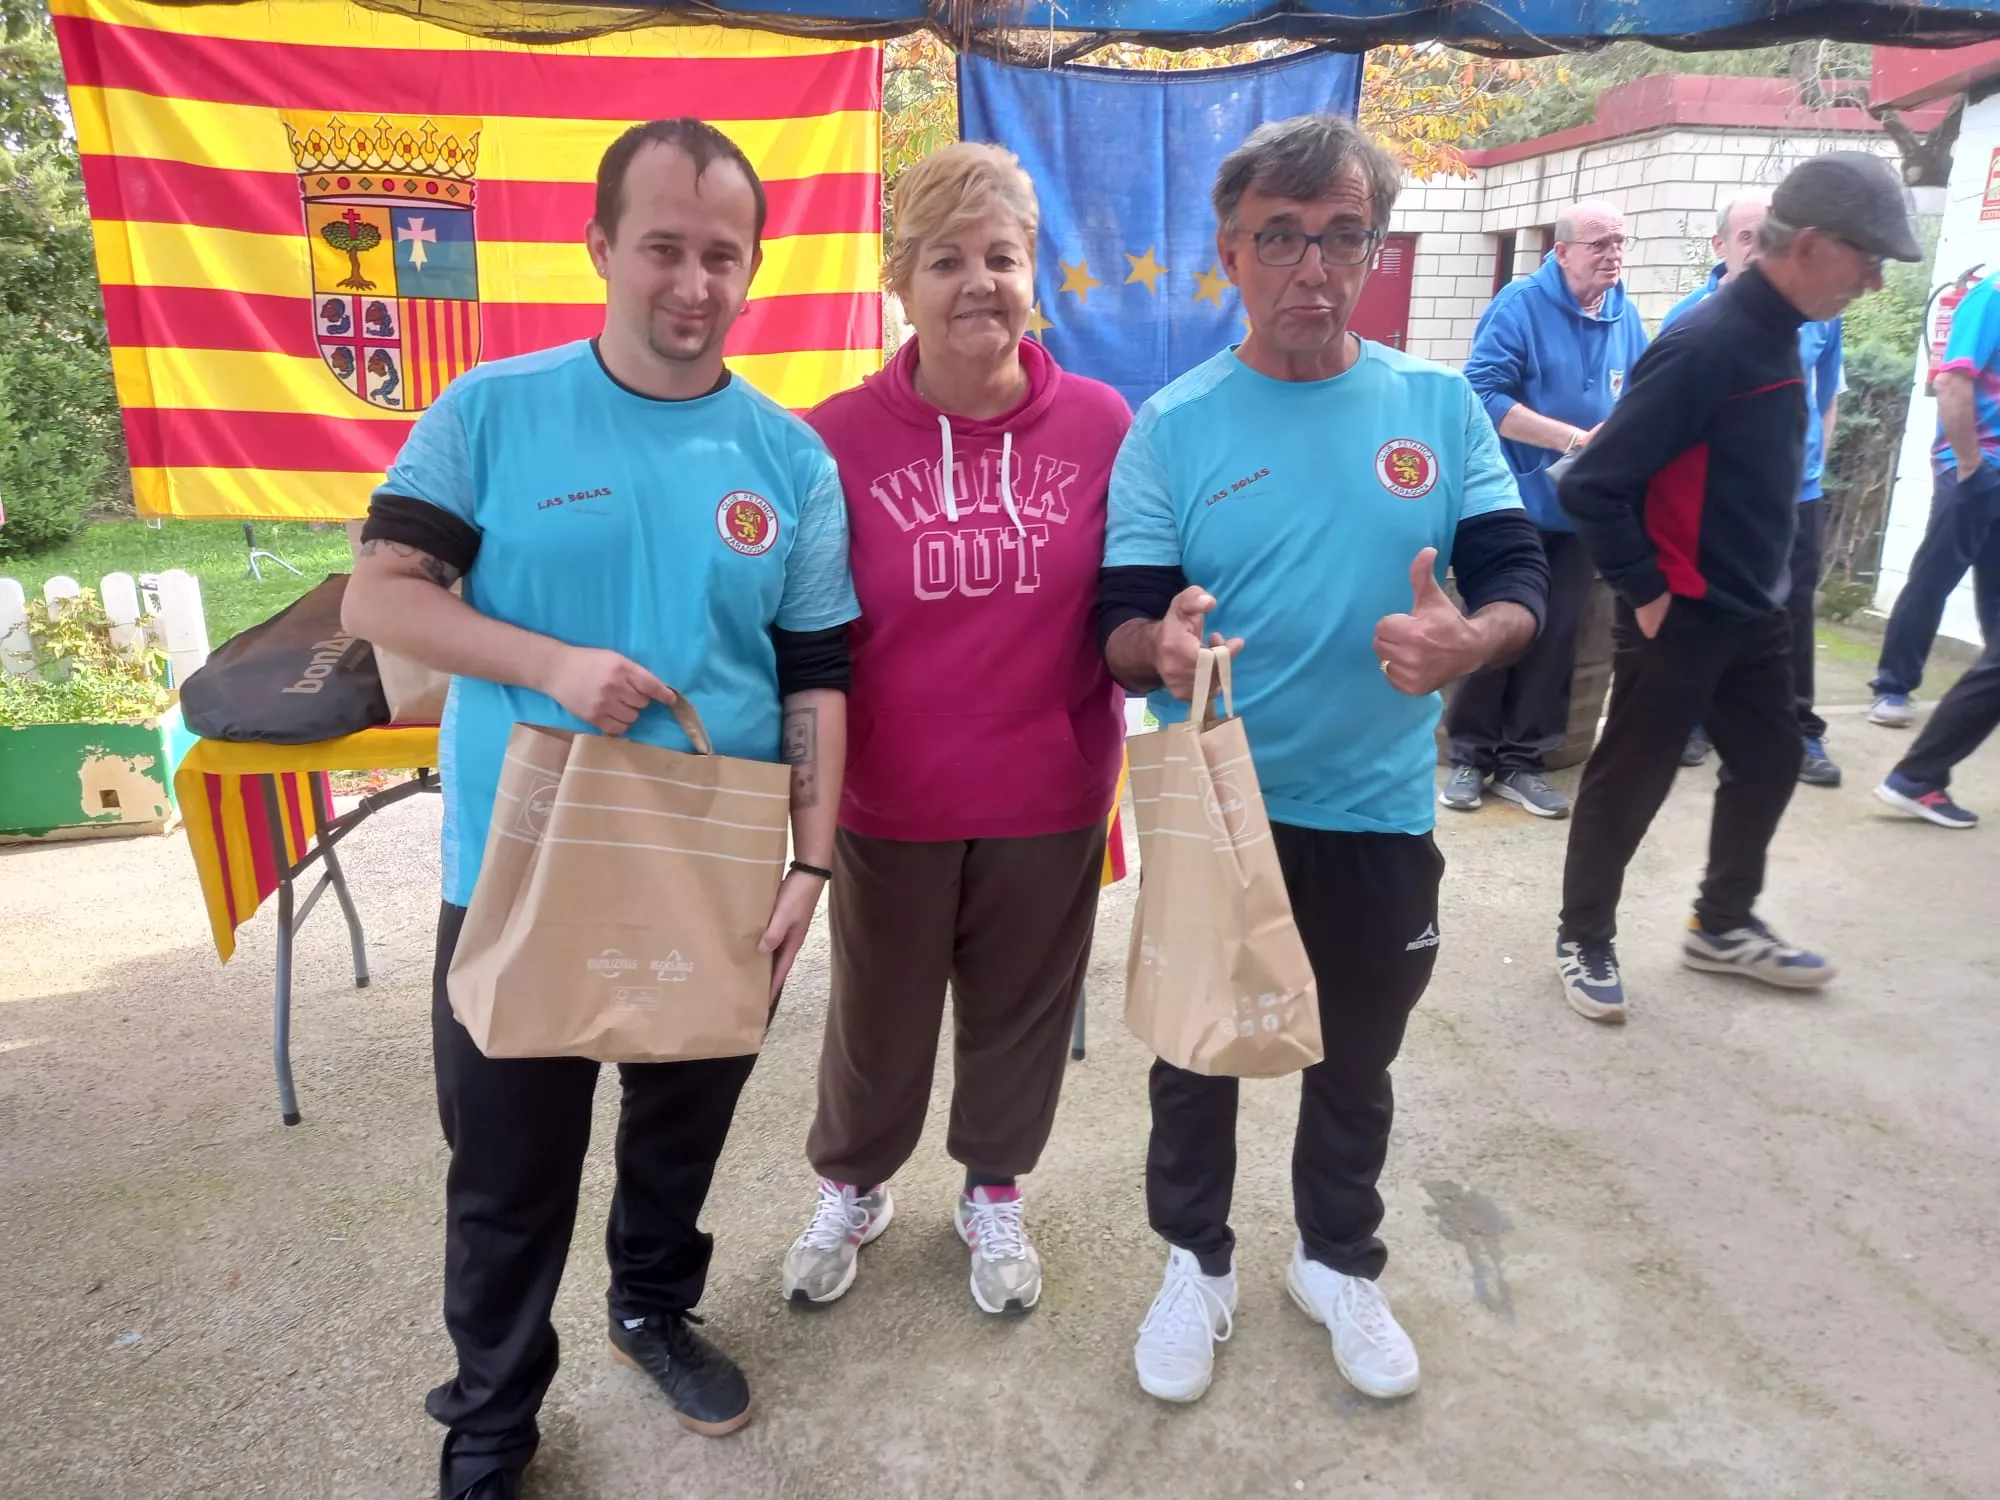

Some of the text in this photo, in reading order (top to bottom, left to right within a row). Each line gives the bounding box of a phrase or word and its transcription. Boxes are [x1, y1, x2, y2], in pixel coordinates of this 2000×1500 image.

[536, 487, 612, 511] LAS BOLAS
[870, 448, 1081, 532] WORK
[1205, 489, 1229, 507] LAS
[1230, 467, 1271, 493] BOLAS
[721, 493, 775, 522] CLUB PETANCA
[725, 535, 766, 553] ZARAGOZA
[912, 523, 1050, 601] OUT
